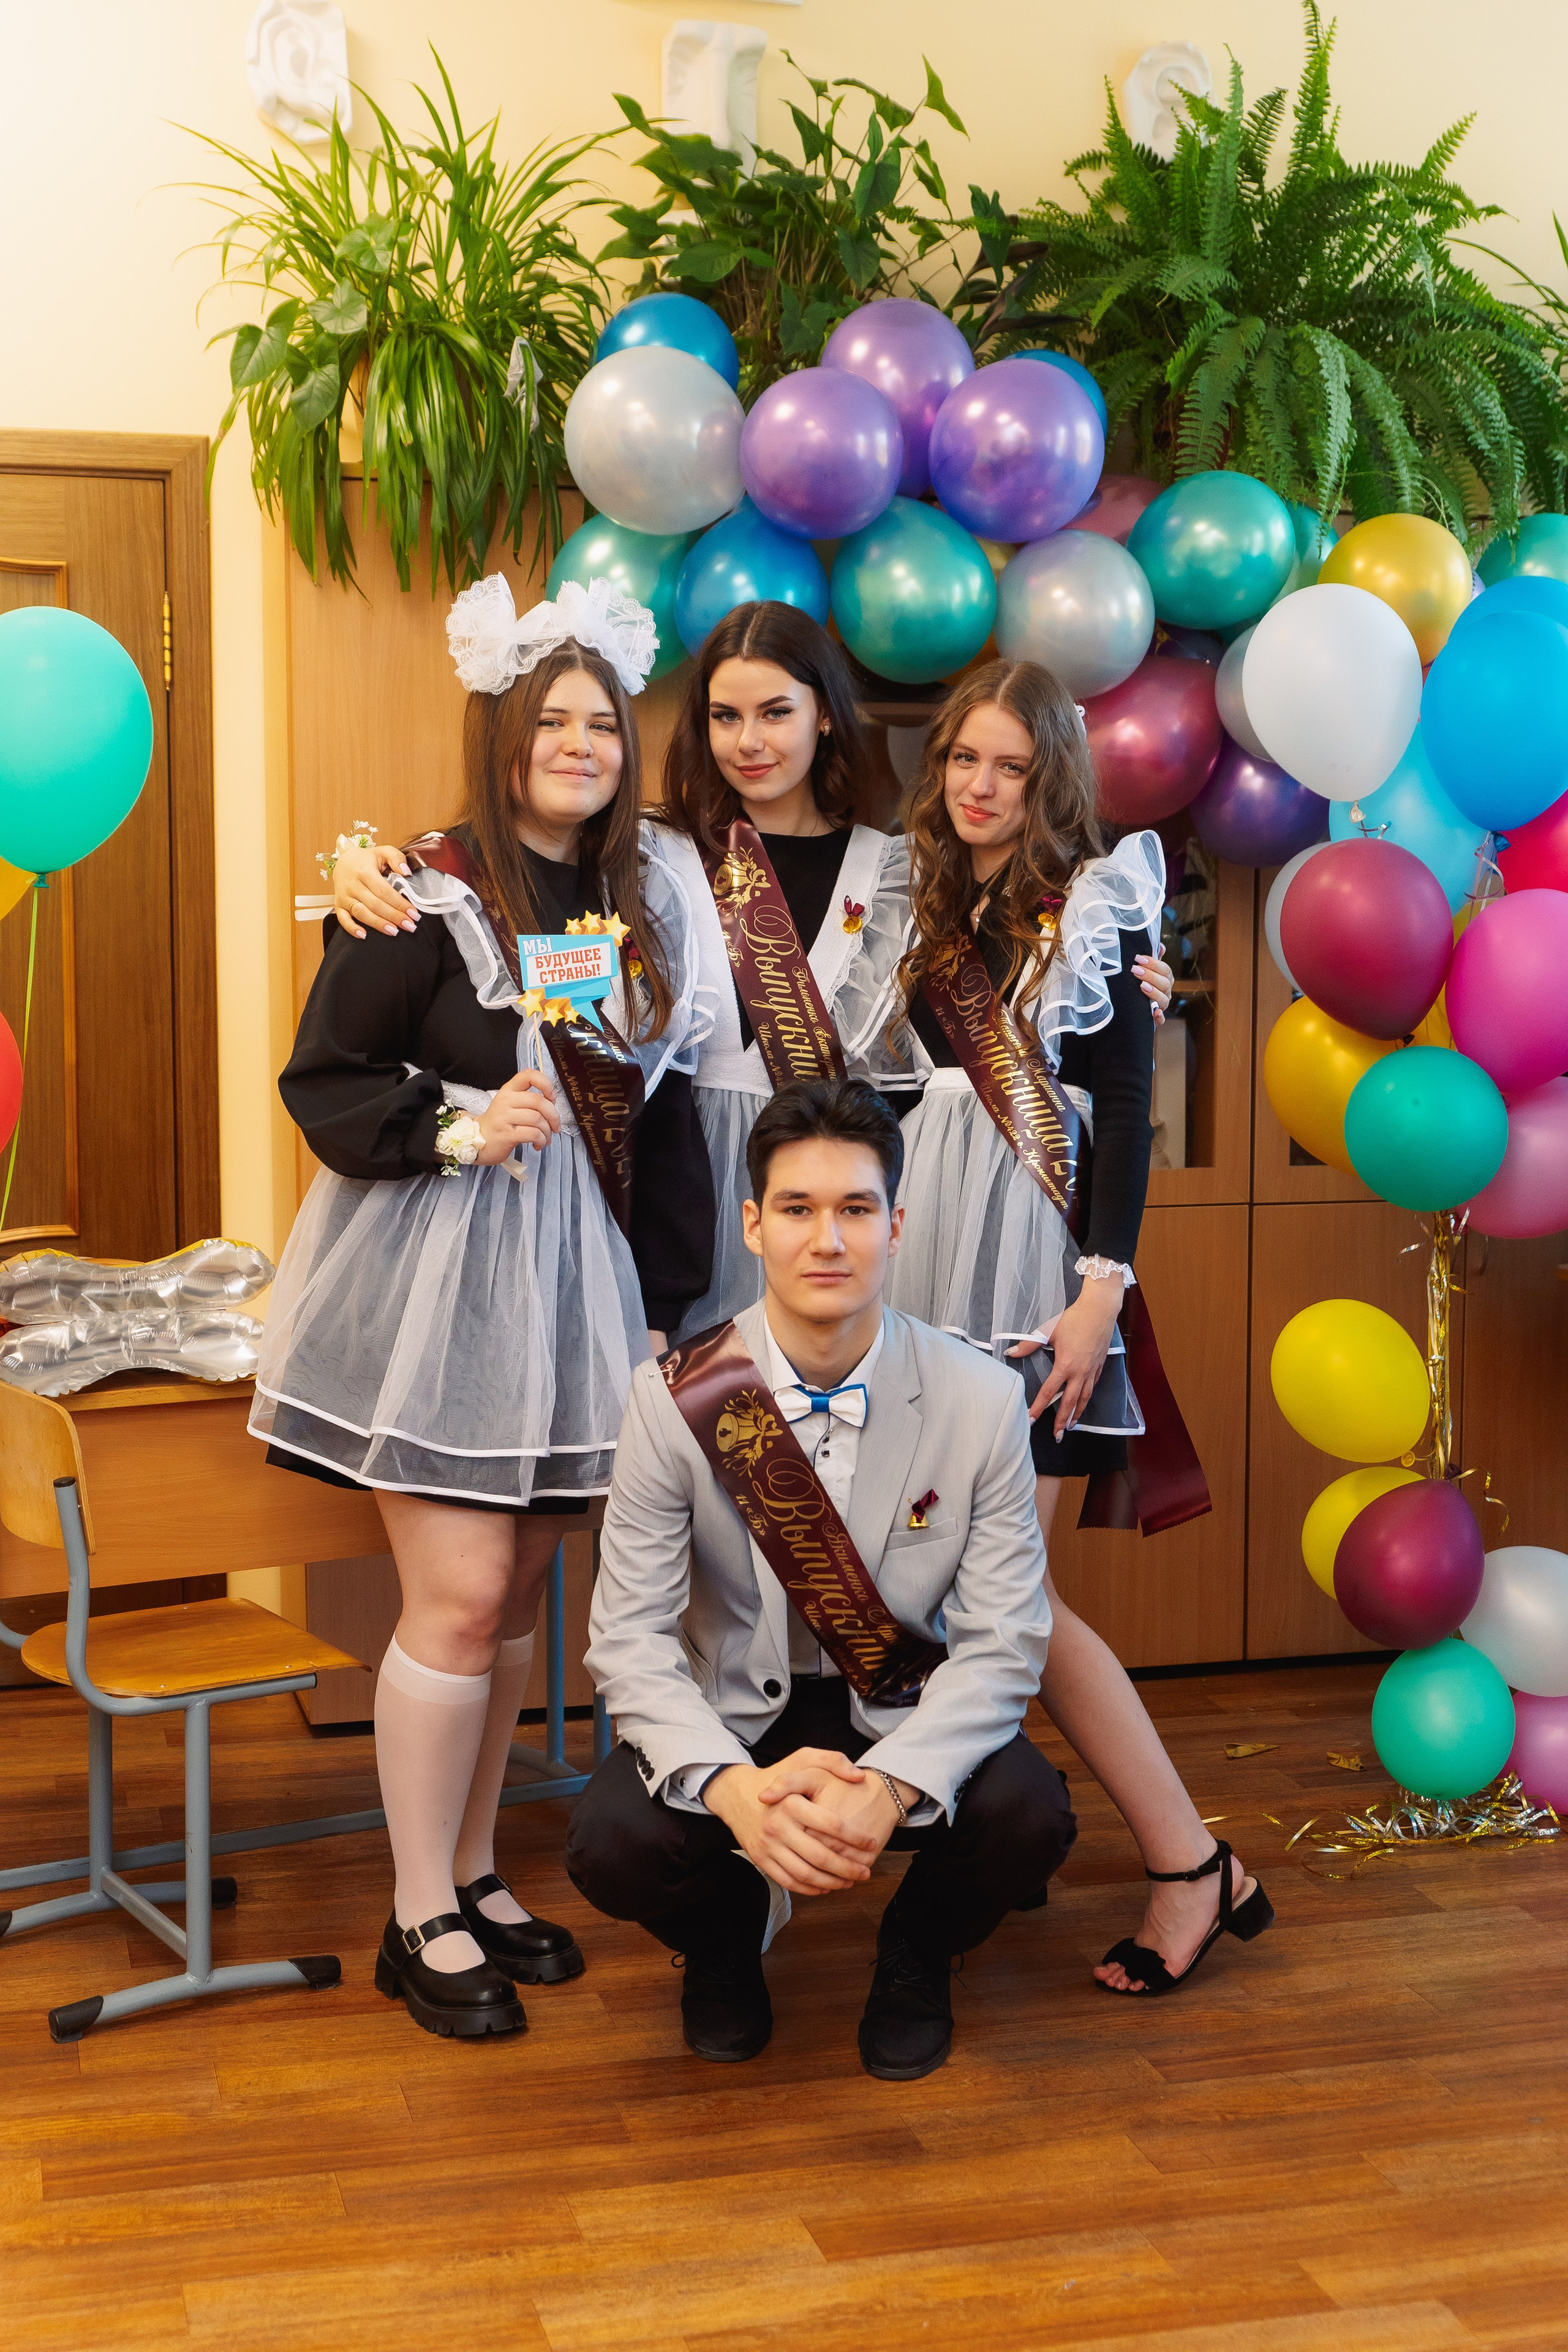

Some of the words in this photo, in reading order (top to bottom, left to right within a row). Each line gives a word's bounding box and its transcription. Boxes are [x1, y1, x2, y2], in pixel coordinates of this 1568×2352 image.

[522, 937, 553, 956] МЫ
[535, 948, 601, 969] БУДУЩЕЕ
[539, 963, 601, 984] СТРАНЫ!
[739, 905, 818, 1082] Выпускни
[791, 966, 818, 1023] Филоненко
[602, 1026, 628, 1065] Алиса
[758, 1022, 775, 1060] Школа
[941, 1017, 956, 1039] «Б»
[951, 963, 1073, 1155] Выпускница
[550, 1031, 568, 1071] Школа
[564, 1071, 582, 1102] №422
[580, 1112, 608, 1174] Кронштадт
[1026, 1057, 1066, 1112] Марианна
[981, 1078, 1000, 1114] Школа
[997, 1114, 1020, 1143] №422
[1022, 1148, 1069, 1210] Кронштадт
[736, 1493, 751, 1507] 11
[747, 1507, 769, 1537] «Б»
[821, 1522, 869, 1604] Якименко
